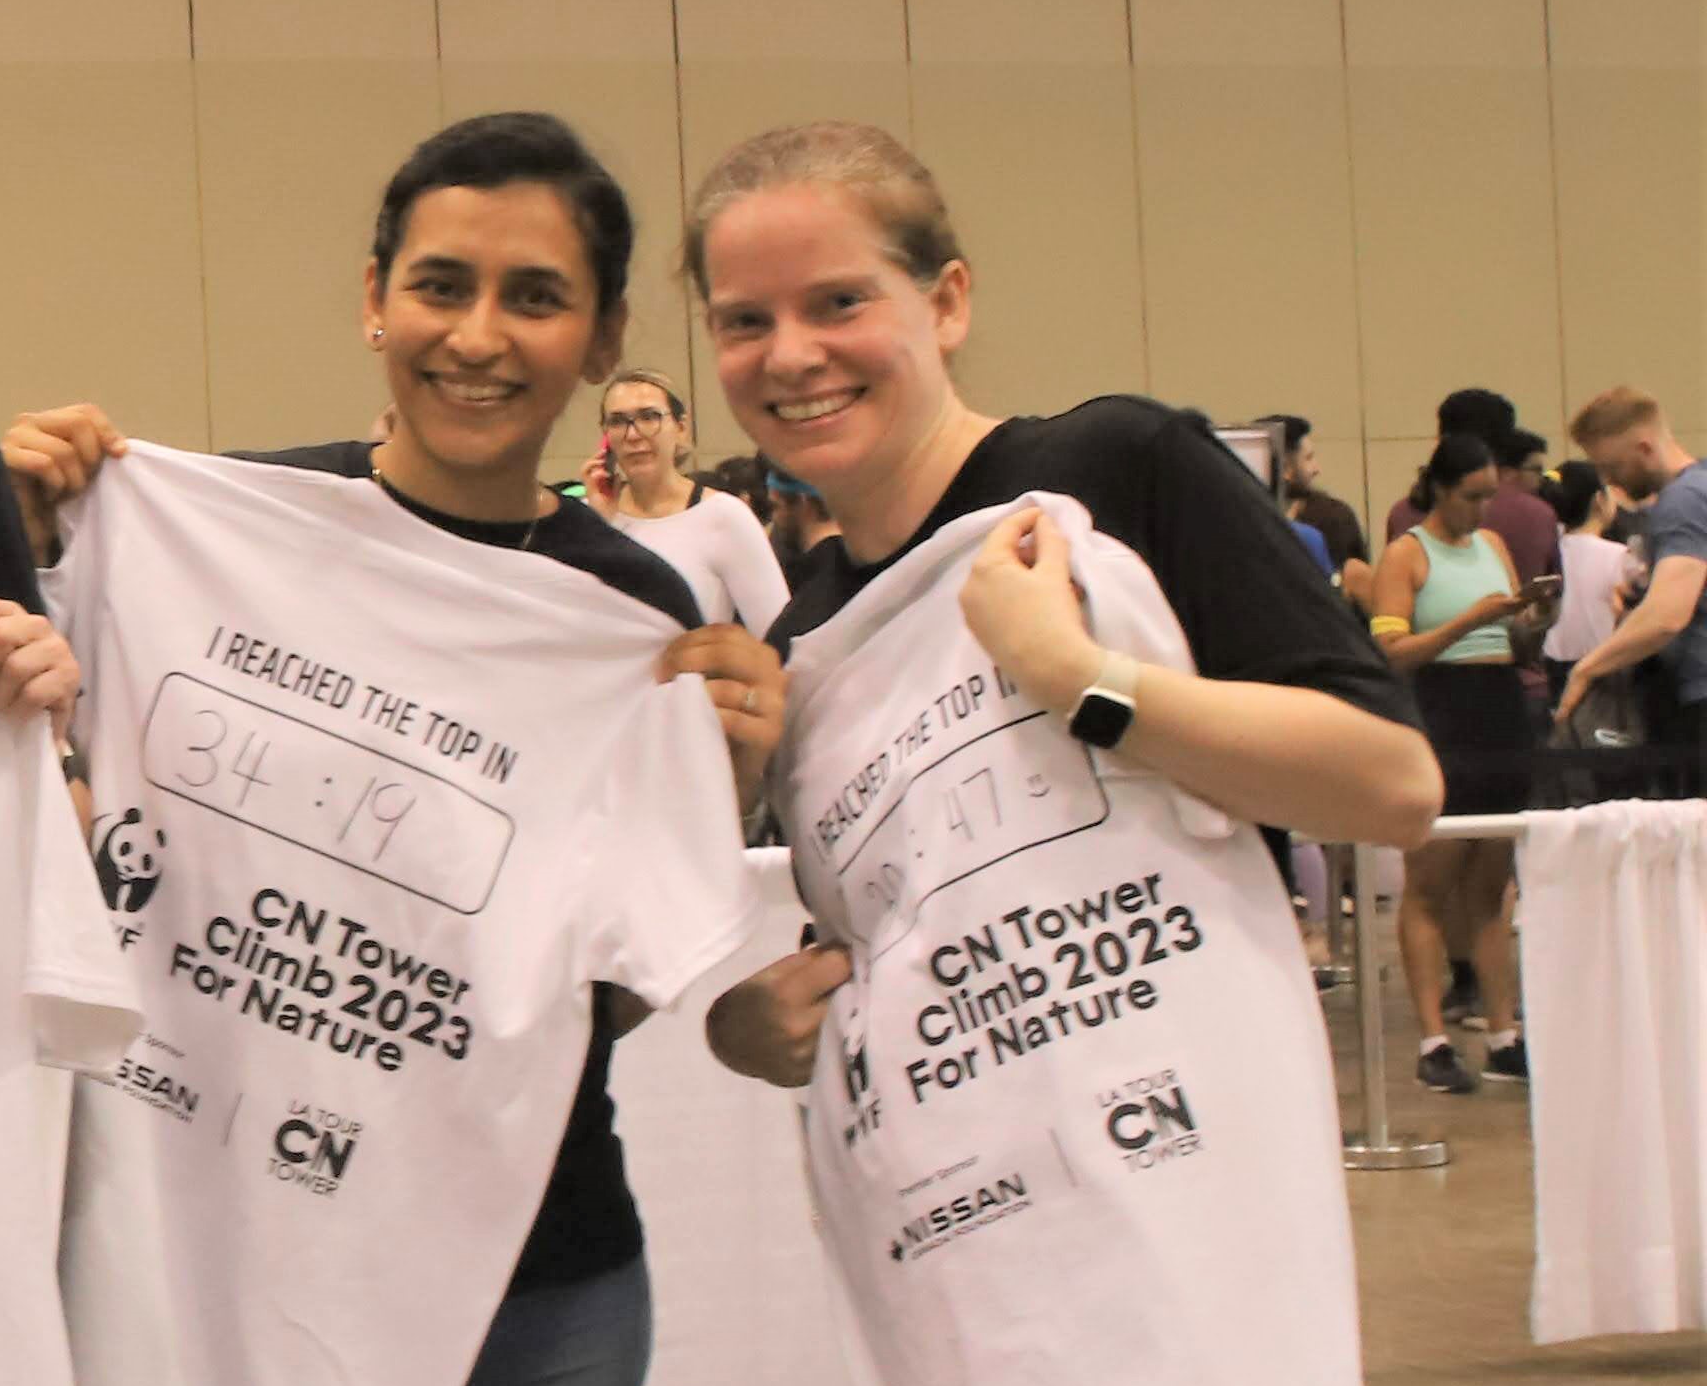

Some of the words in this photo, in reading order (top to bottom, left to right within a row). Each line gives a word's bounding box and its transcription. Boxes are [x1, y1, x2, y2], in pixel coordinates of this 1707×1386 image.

[205, 625, 226, 661] I
[223, 632, 356, 712] REACHED
[360, 684, 418, 737] THE
[421, 712, 481, 764] TOP
[479, 740, 519, 785] IN
[894, 708, 934, 765] THE
[934, 674, 988, 730] TOP
[205, 915, 335, 1000] Climb
[341, 974, 474, 1061] 2023
[251, 887, 329, 947] CN
[338, 916, 472, 1006] Tower
[917, 960, 1050, 1049] Climb
[1053, 904, 1206, 992] 2023
[928, 923, 1004, 989] CN
[1000, 870, 1164, 951] Tower
[169, 943, 236, 1003] For
[240, 983, 405, 1074] Nature
[904, 1050, 981, 1105] For
[986, 975, 1161, 1068] Nature
[274, 1118, 356, 1180] CN
[1105, 1084, 1198, 1151] CN
[1120, 1131, 1203, 1174] TOWER
[267, 1157, 341, 1198] TOWER
[902, 1172, 1028, 1245] NISSAN
